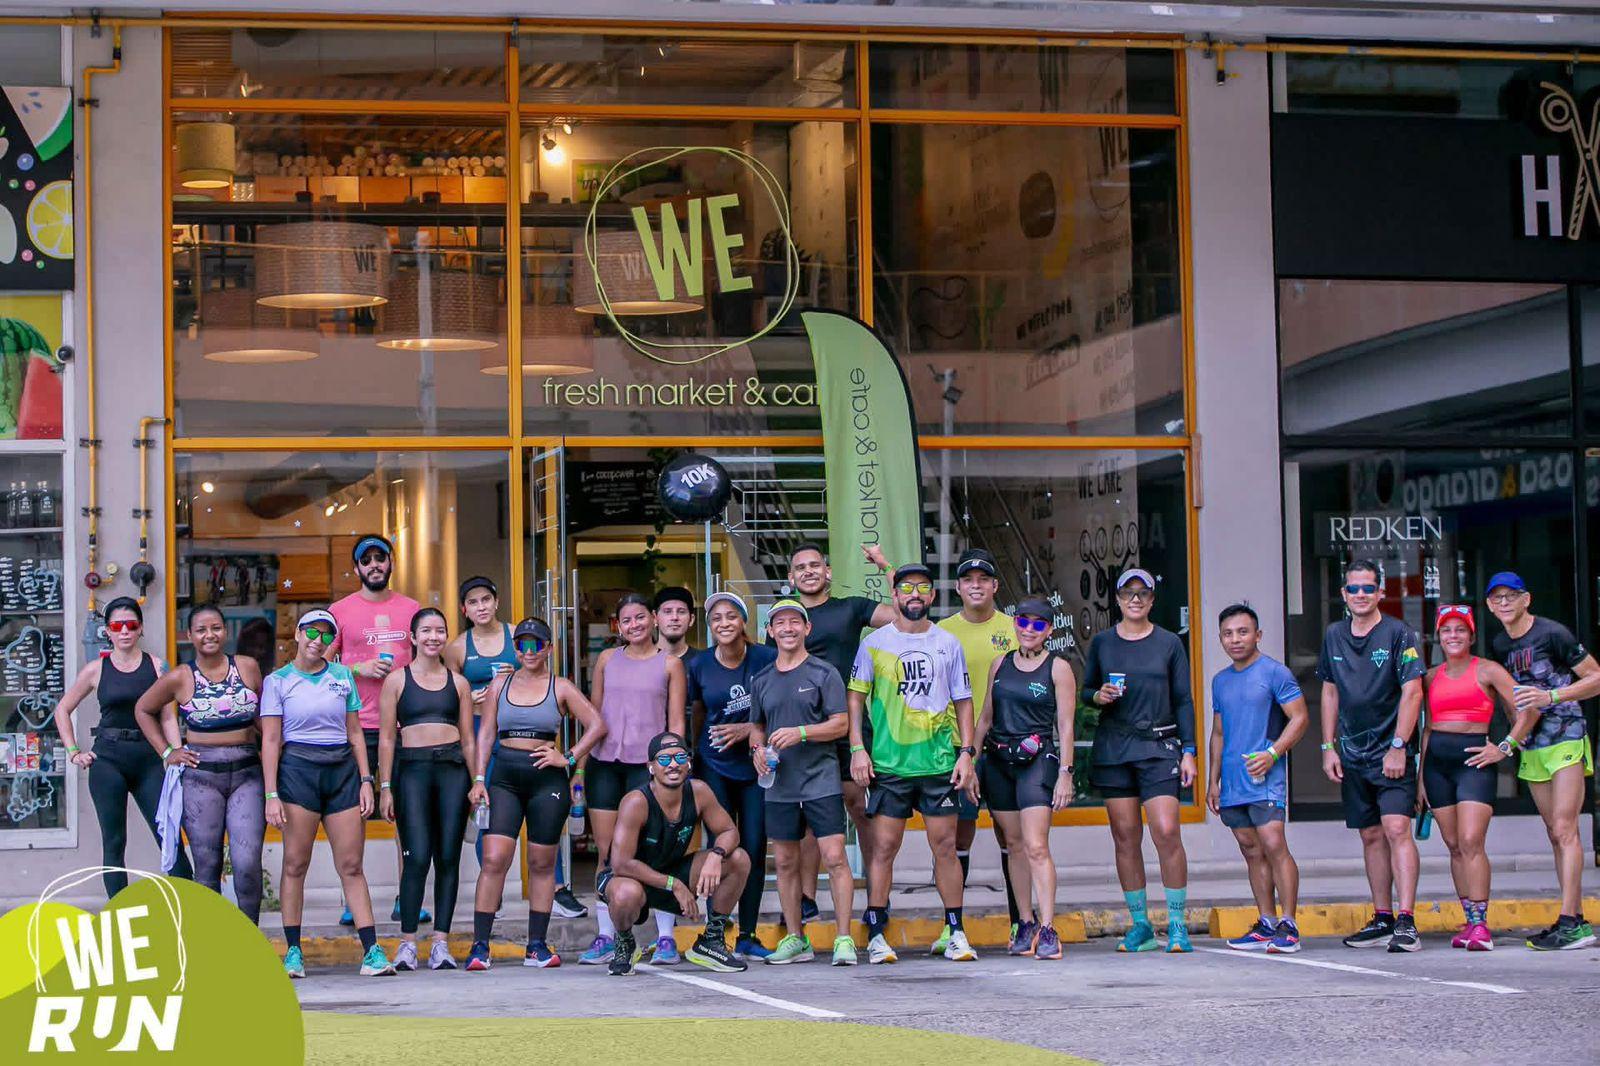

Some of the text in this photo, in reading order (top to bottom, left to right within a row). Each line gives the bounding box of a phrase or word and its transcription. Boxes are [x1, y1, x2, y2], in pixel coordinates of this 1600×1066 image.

[631, 193, 753, 300] WE
[543, 377, 619, 406] fresh
[626, 377, 737, 406] market
[743, 377, 767, 405] &
[855, 435, 878, 455] &
[681, 463, 716, 488] 10K
[1078, 461, 1094, 499] WE
[1330, 516, 1442, 541] REDKEN
[902, 660, 927, 681] WE
[897, 681, 933, 696] RUN
